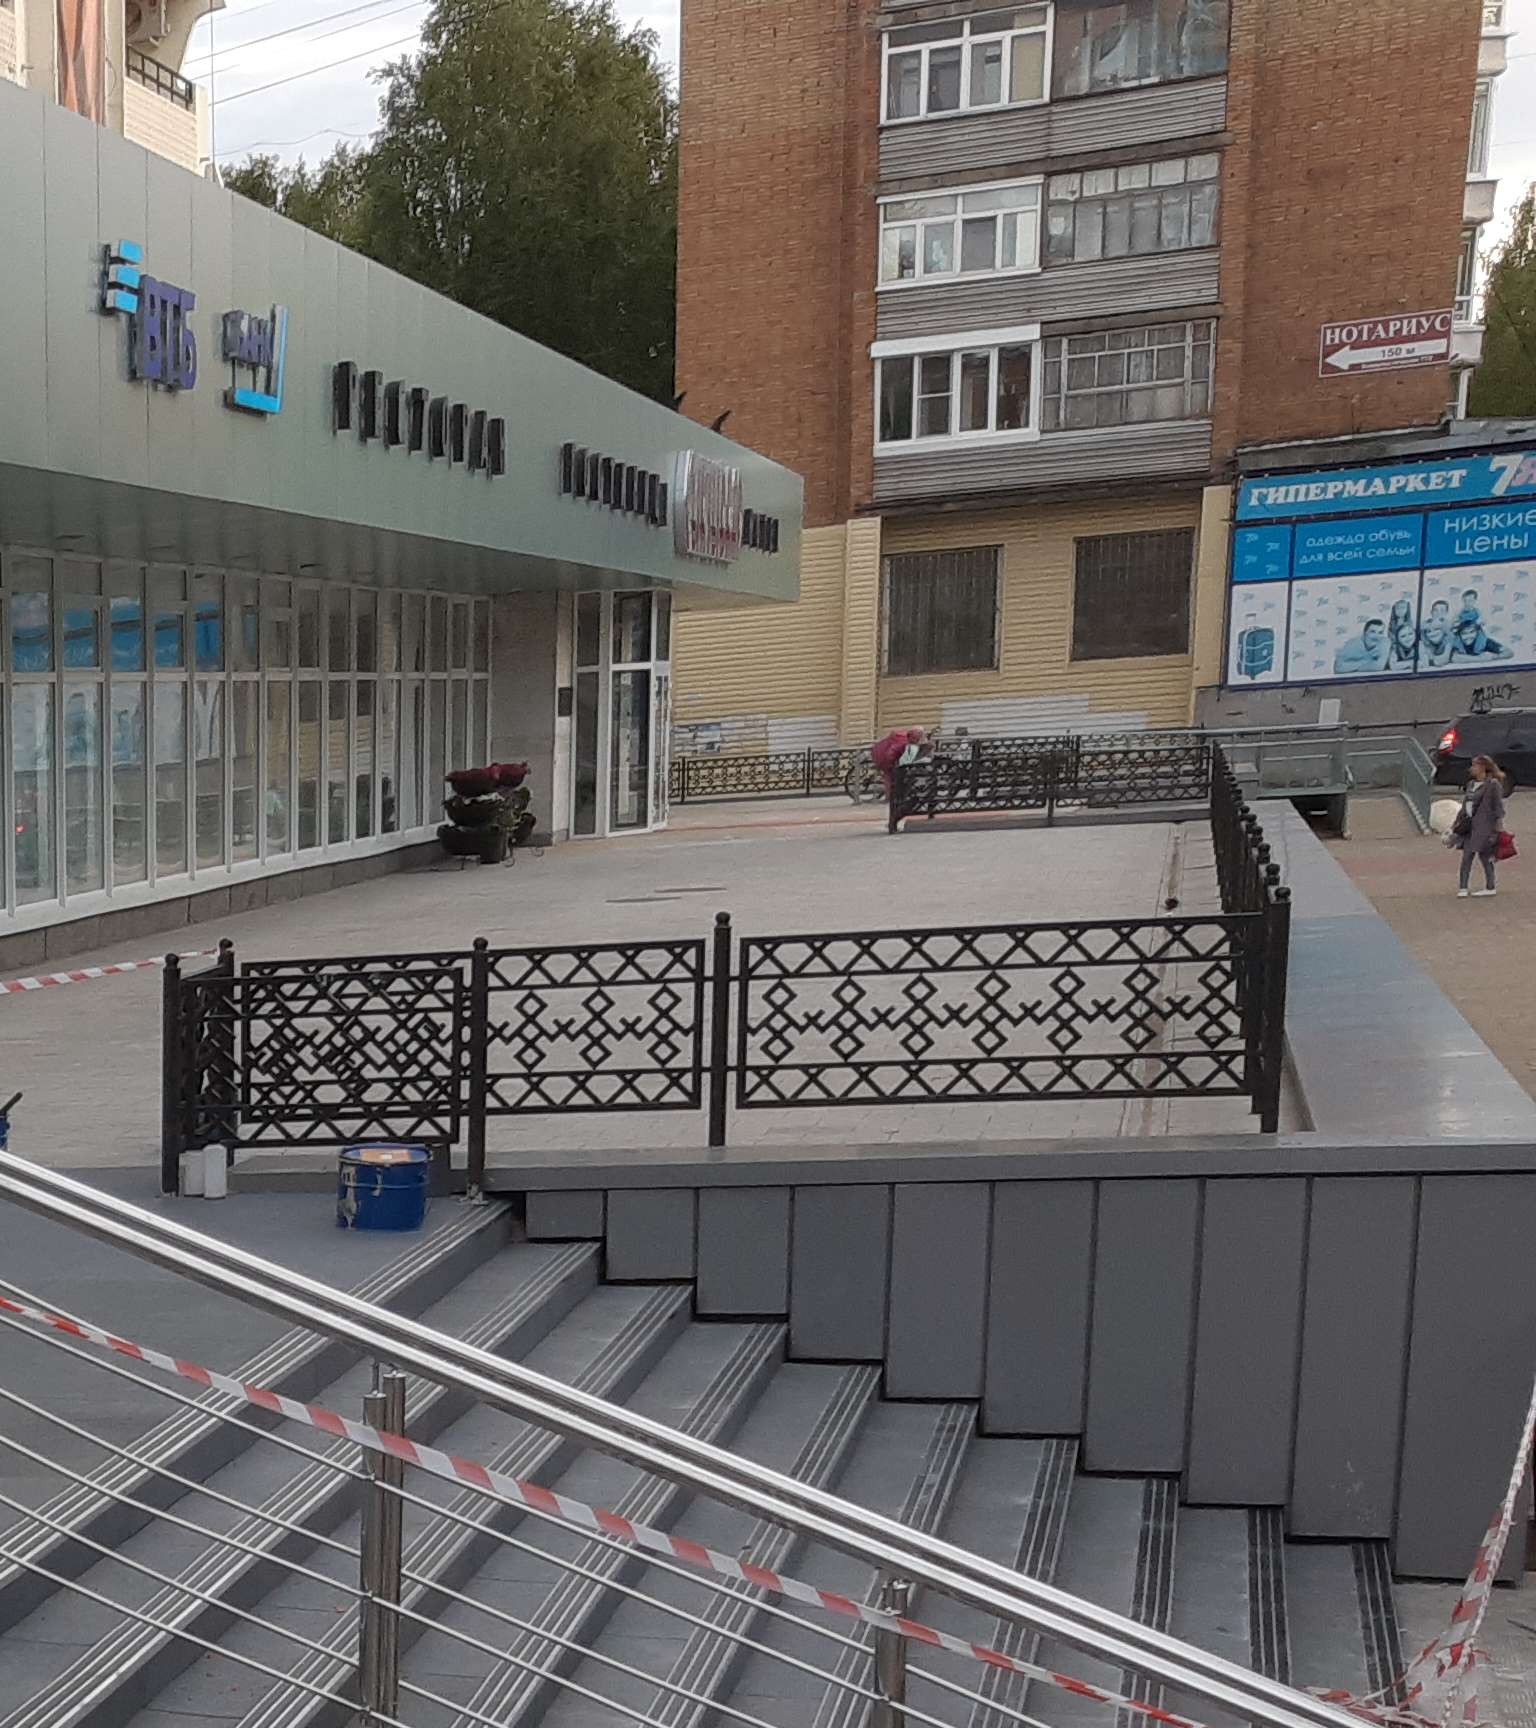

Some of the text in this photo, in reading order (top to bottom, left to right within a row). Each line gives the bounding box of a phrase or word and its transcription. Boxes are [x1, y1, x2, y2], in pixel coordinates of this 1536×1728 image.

[132, 274, 197, 390] ВТБ
[1324, 313, 1451, 346] НОТАРИУС
[1381, 347, 1402, 358] 150
[1248, 469, 1467, 506] ГИПЕРМАРКЕТ
[1368, 529, 1411, 543] обувь
[1299, 545, 1416, 564] для всей семьи
